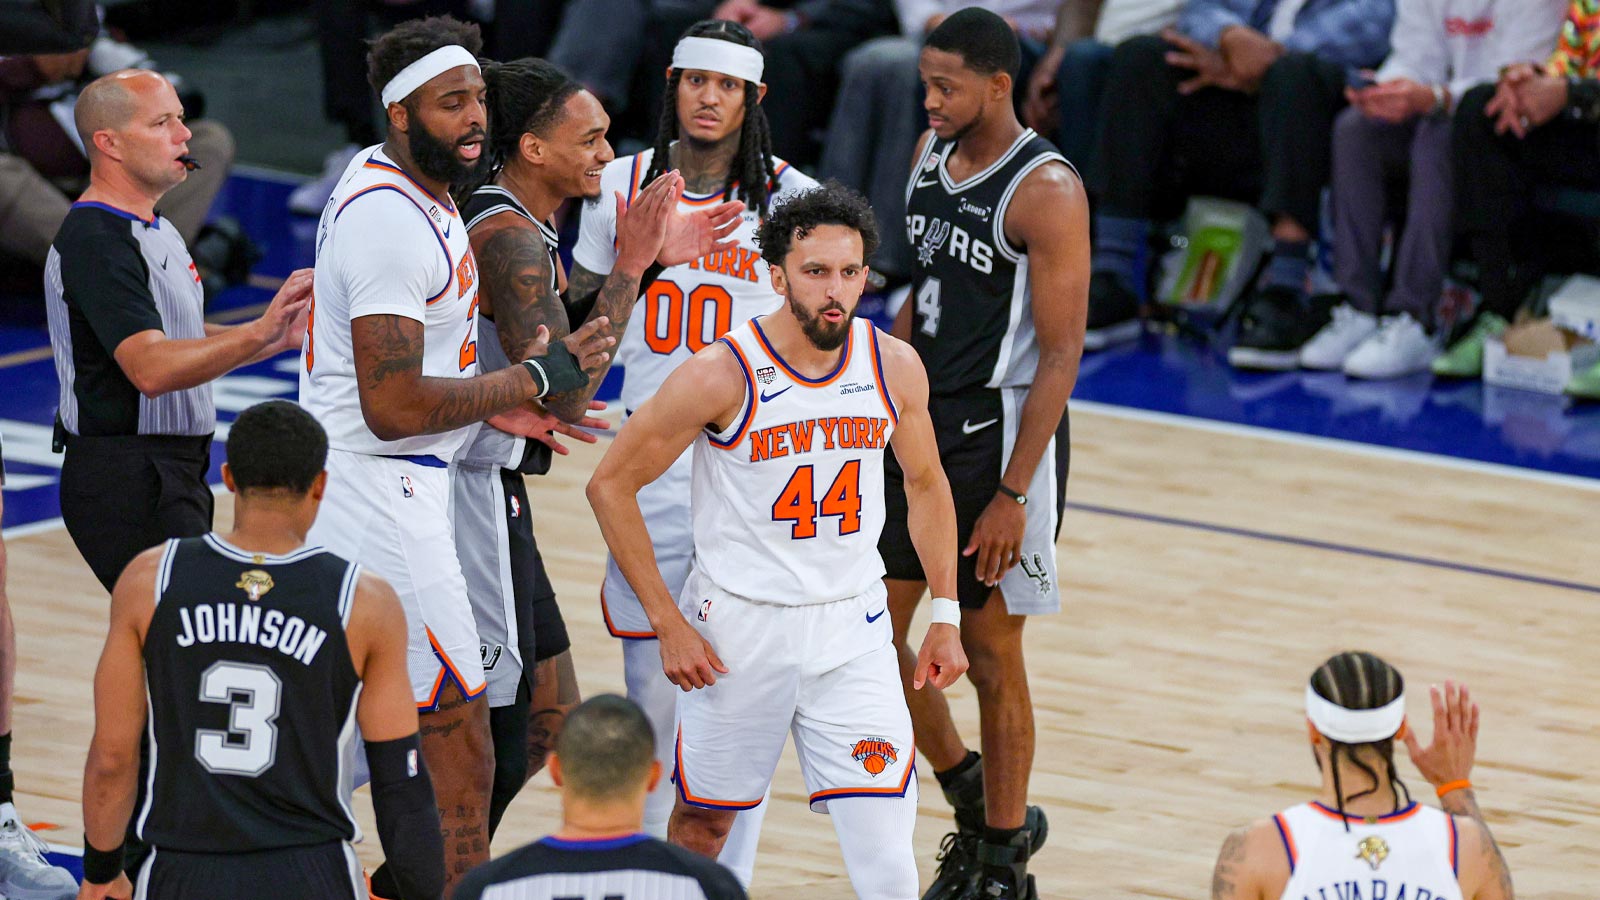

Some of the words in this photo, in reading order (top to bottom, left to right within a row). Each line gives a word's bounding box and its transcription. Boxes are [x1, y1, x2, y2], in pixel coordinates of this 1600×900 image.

[644, 279, 733, 356] 00
[917, 275, 942, 338] 4
[840, 388, 854, 396] abu
[854, 383, 875, 393] dhabi
[750, 419, 816, 463] NEW
[818, 416, 889, 450] YORK
[771, 459, 863, 540] 44
[176, 602, 328, 667] JOHNSON
[194, 659, 284, 778] 3
[851, 739, 898, 762] KNICKS
[1303, 879, 1448, 900] VARA
